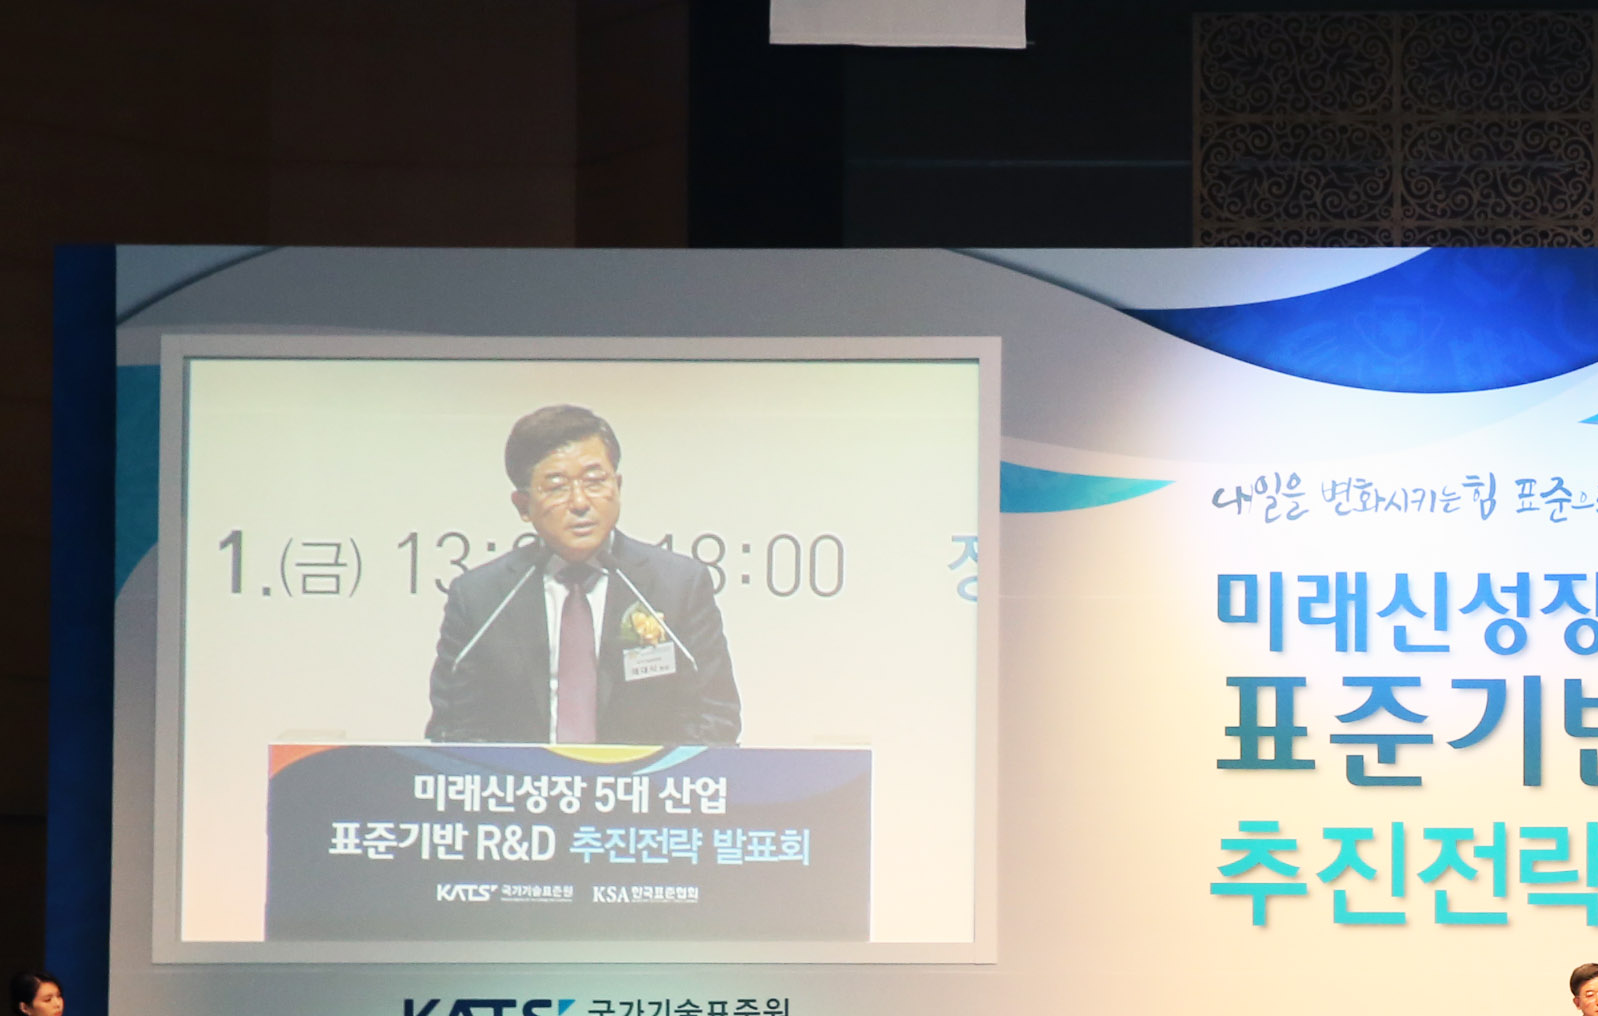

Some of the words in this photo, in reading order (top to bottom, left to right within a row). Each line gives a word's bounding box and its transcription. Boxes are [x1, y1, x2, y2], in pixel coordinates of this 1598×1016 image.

[414, 773, 586, 813] 미래신성장
[595, 776, 648, 814] 5대
[659, 776, 727, 814] 산업
[329, 821, 468, 860] 표준기반
[478, 824, 556, 861] R&D
[570, 825, 702, 864] 추진전략
[713, 827, 810, 865] 발표회
[437, 884, 492, 901] KATS
[593, 886, 629, 902] KSA
